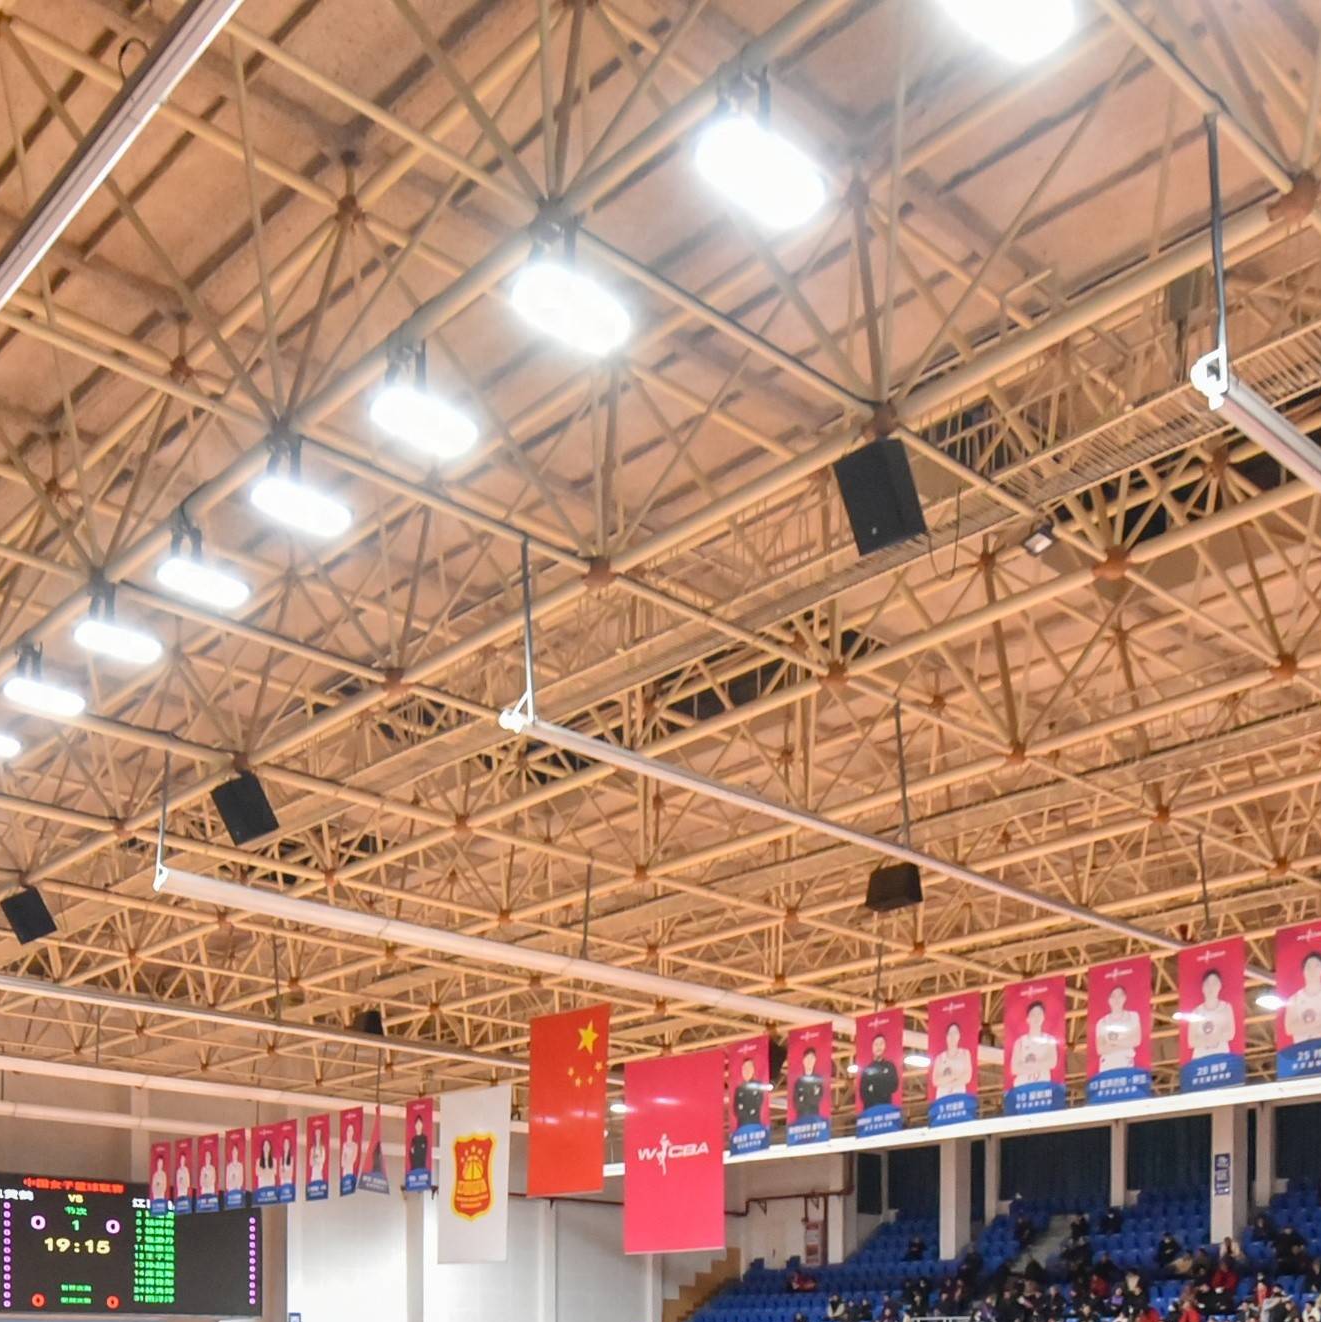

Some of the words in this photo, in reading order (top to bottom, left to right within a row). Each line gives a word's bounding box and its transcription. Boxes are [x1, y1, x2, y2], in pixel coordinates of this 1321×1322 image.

[30, 1215, 46, 1230] 0
[72, 1220, 80, 1231] 1
[105, 1219, 121, 1234] 0
[44, 1237, 111, 1254] 19:15
[32, 1293, 45, 1307] 0
[106, 1295, 119, 1309] 0
